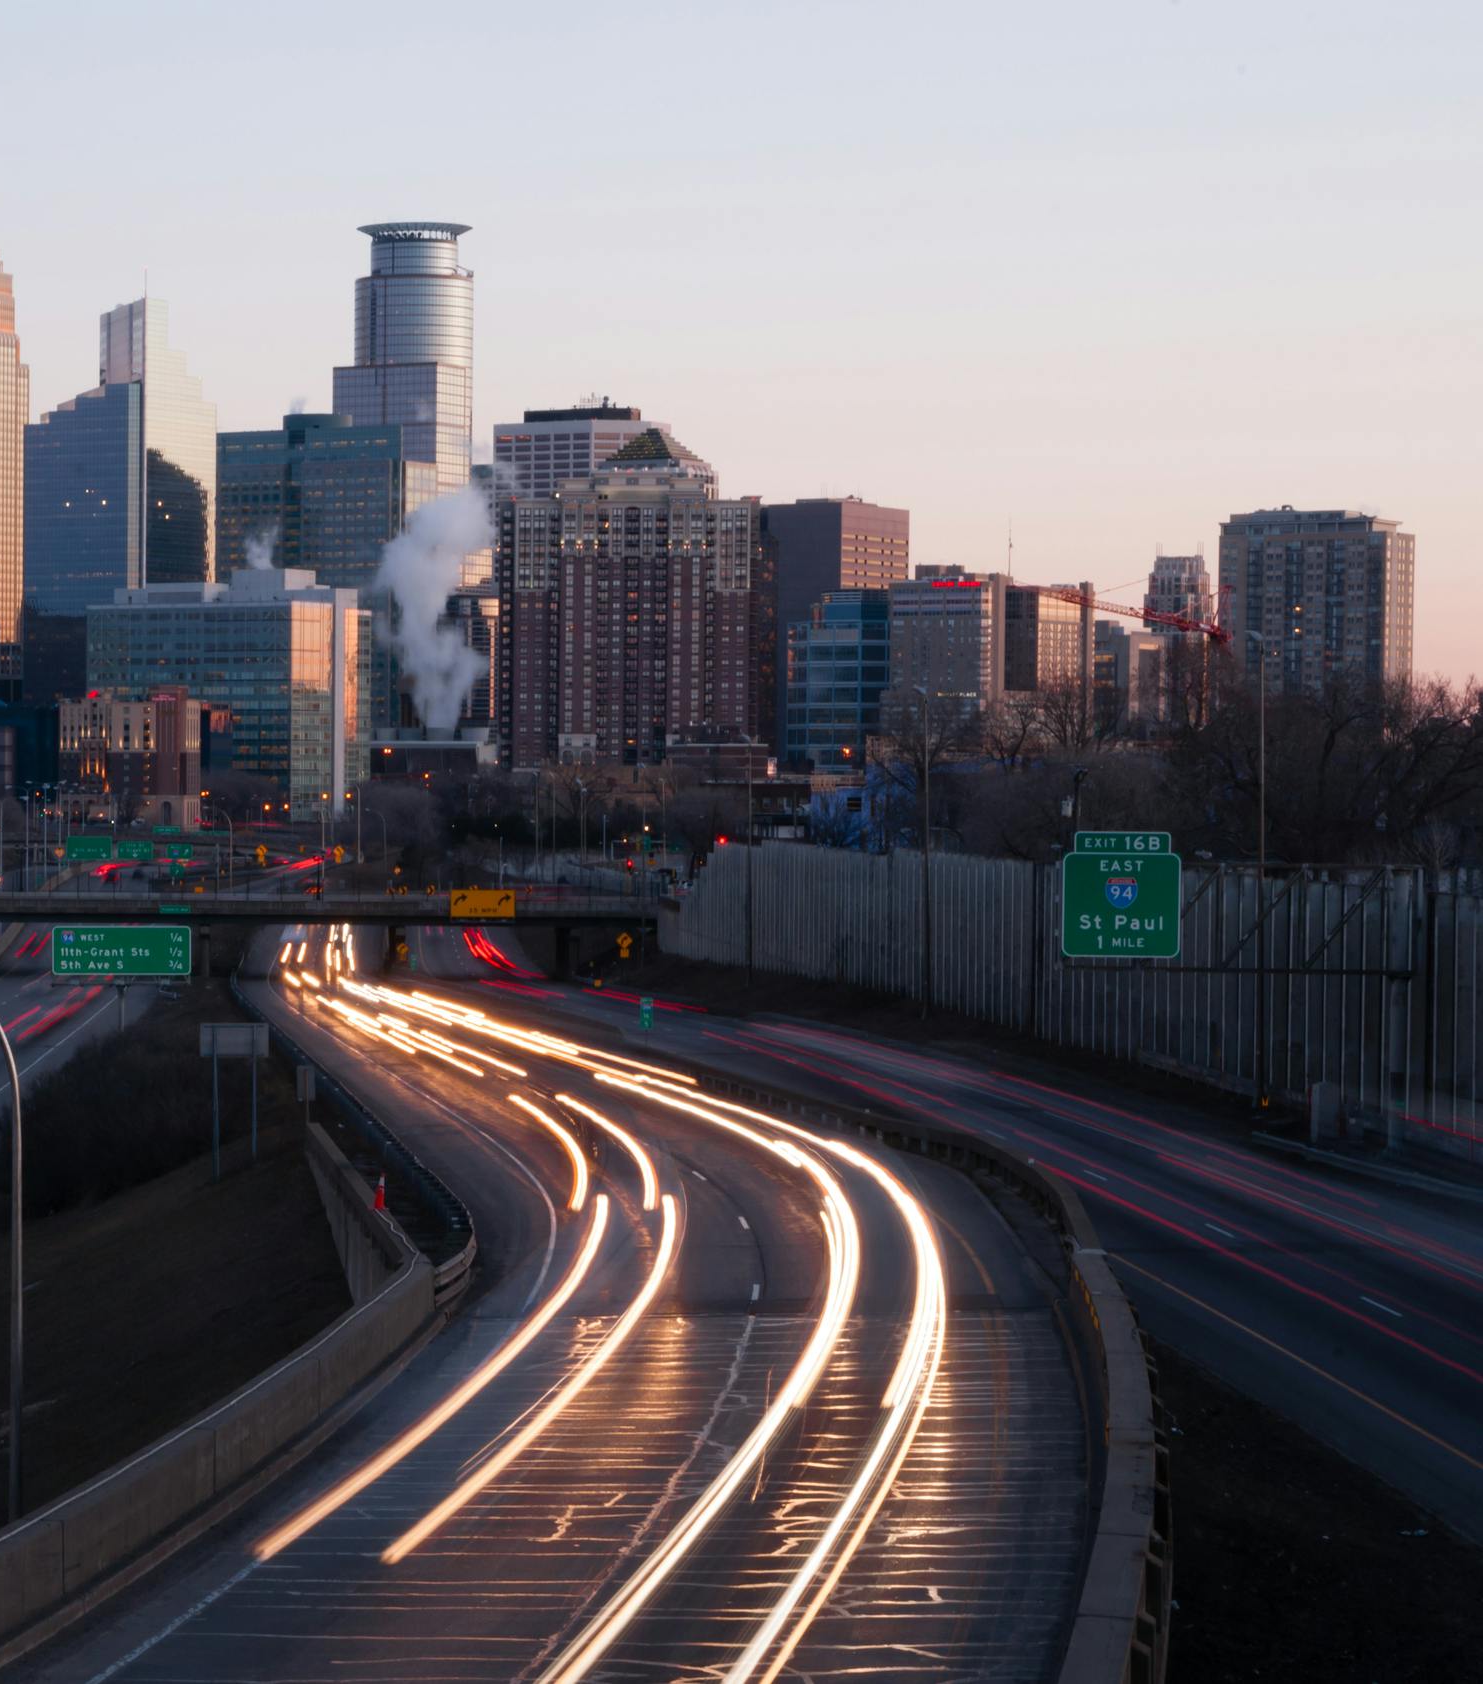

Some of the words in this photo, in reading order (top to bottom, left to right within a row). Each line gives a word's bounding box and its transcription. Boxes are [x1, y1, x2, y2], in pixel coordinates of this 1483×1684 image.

[1084, 838, 1117, 848] EXIT
[1124, 836, 1161, 851] 16B
[1100, 860, 1144, 871] EAST
[1110, 886, 1133, 900] 94
[1079, 915, 1102, 929] St
[1114, 915, 1164, 931] Paul
[1097, 935, 1103, 949] 1
[1112, 938, 1145, 948] MILE
[61, 947, 124, 957] 11th-Grant
[131, 948, 150, 957] Sts
[60, 961, 81, 970] 5th
[88, 961, 110, 970] Ave
[117, 961, 124, 970] S
